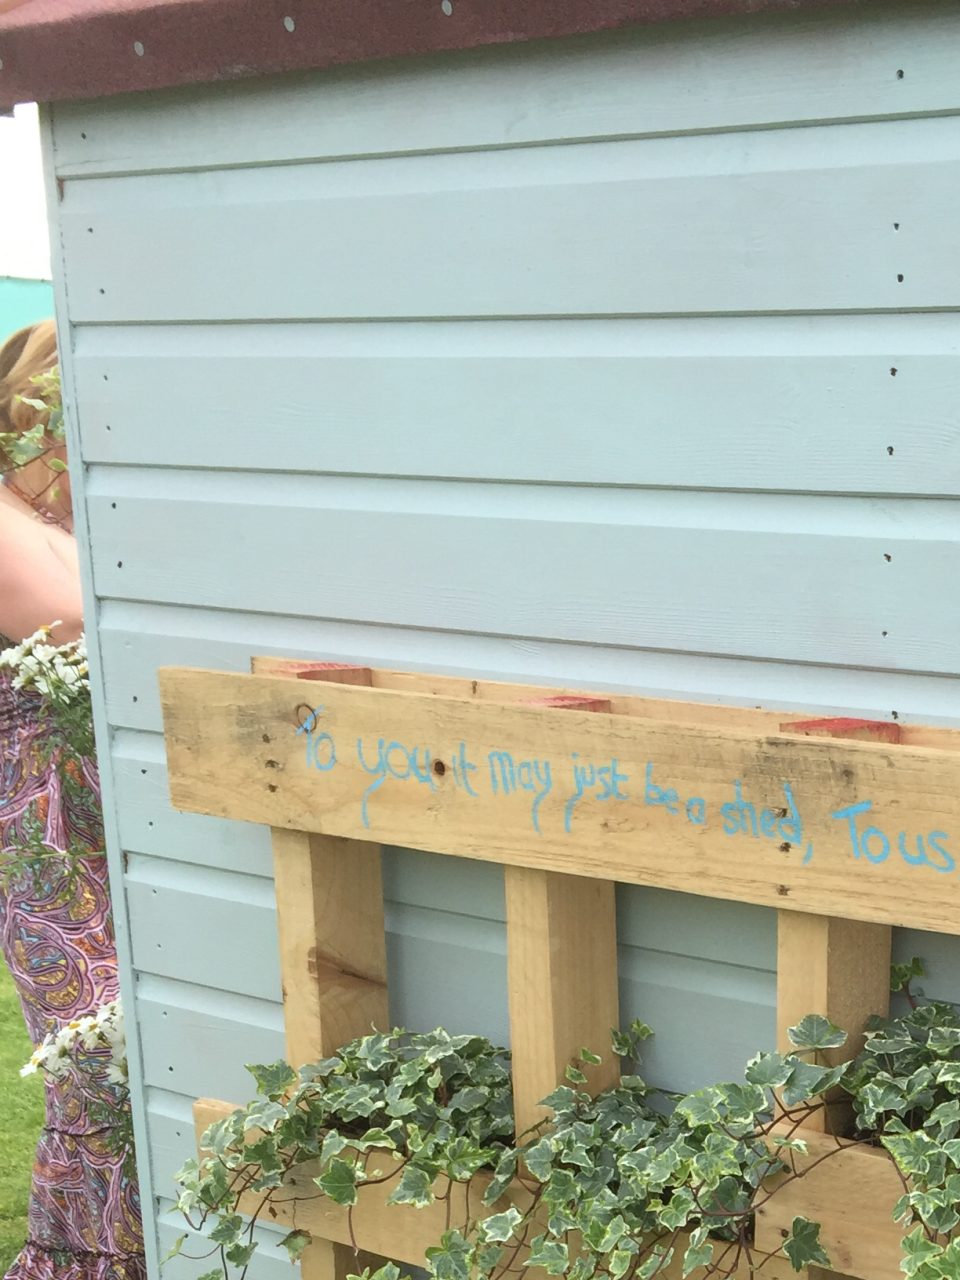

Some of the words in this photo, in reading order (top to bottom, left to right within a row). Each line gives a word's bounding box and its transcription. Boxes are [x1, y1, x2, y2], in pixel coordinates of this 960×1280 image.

[564, 752, 629, 832] just
[645, 760, 679, 815] be
[686, 797, 705, 825] a
